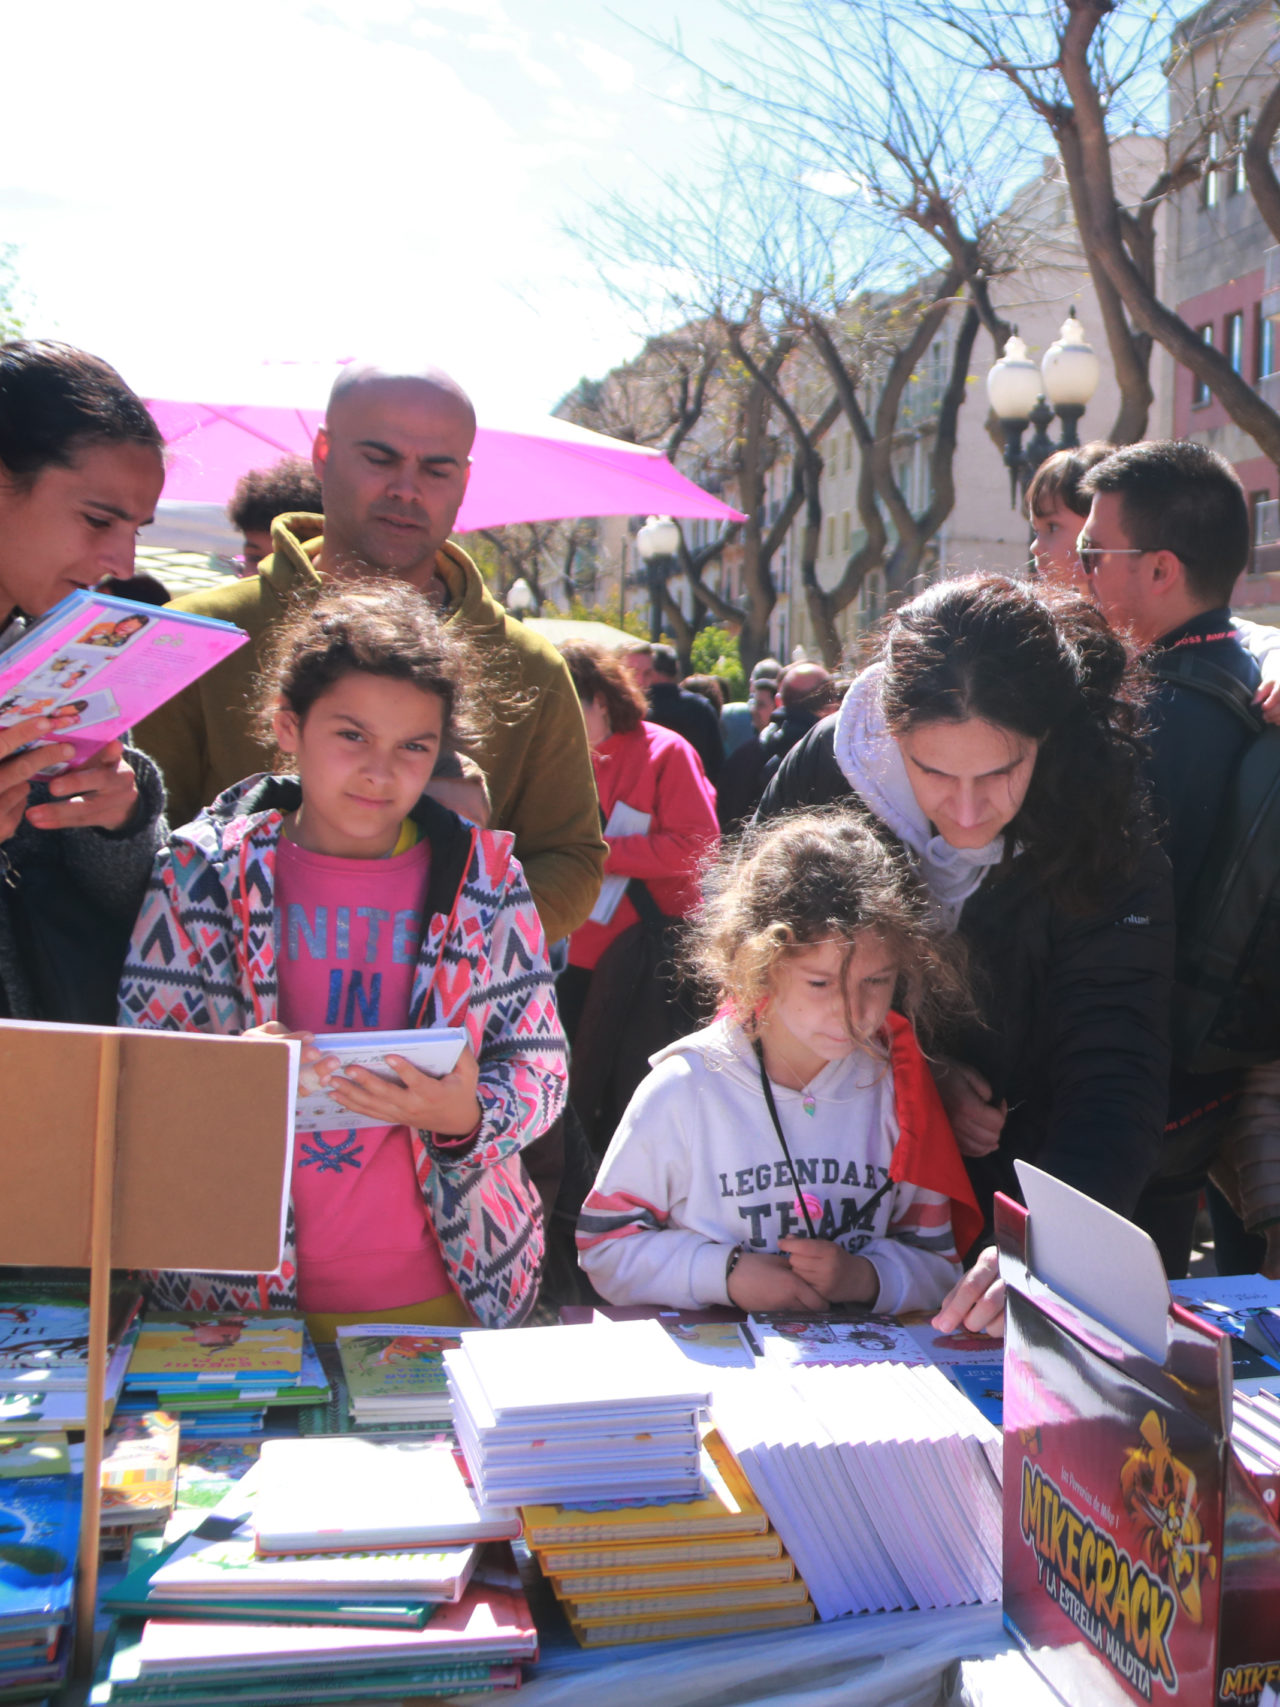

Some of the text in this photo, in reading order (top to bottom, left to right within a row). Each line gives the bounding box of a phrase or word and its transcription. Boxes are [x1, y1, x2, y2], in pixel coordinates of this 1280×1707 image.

[325, 968, 382, 1028] IN
[737, 1197, 882, 1248] TEAM
[1022, 1464, 1174, 1684] MIKECRACK
[1037, 1556, 1150, 1697] Y LA ESTRELLA MALDITA
